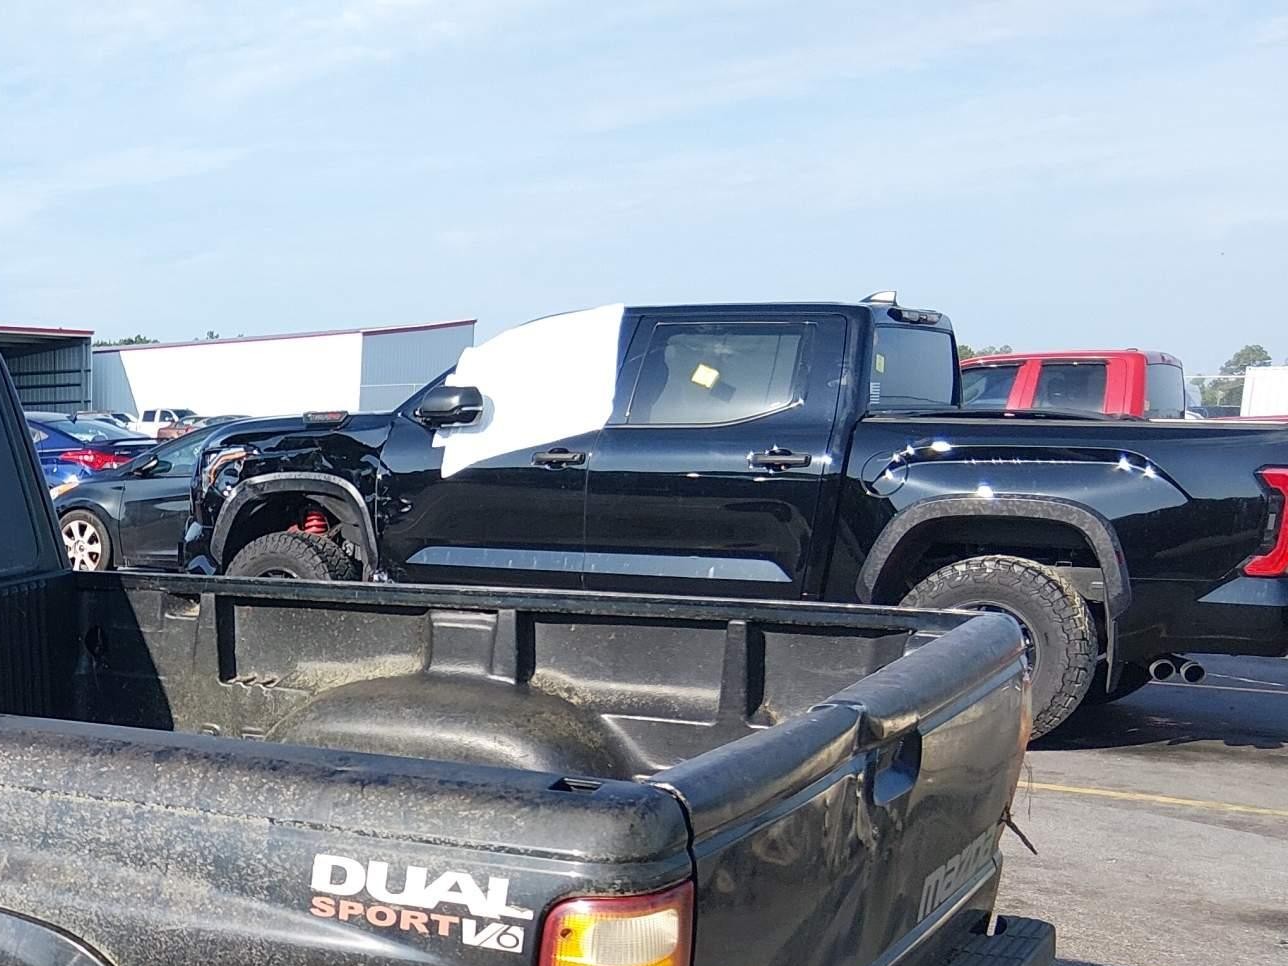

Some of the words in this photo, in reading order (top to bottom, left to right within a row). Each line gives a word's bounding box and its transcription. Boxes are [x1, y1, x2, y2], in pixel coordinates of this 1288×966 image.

[311, 853, 534, 921] DUAL
[310, 896, 460, 937] SPORT
[461, 918, 525, 953] V6
